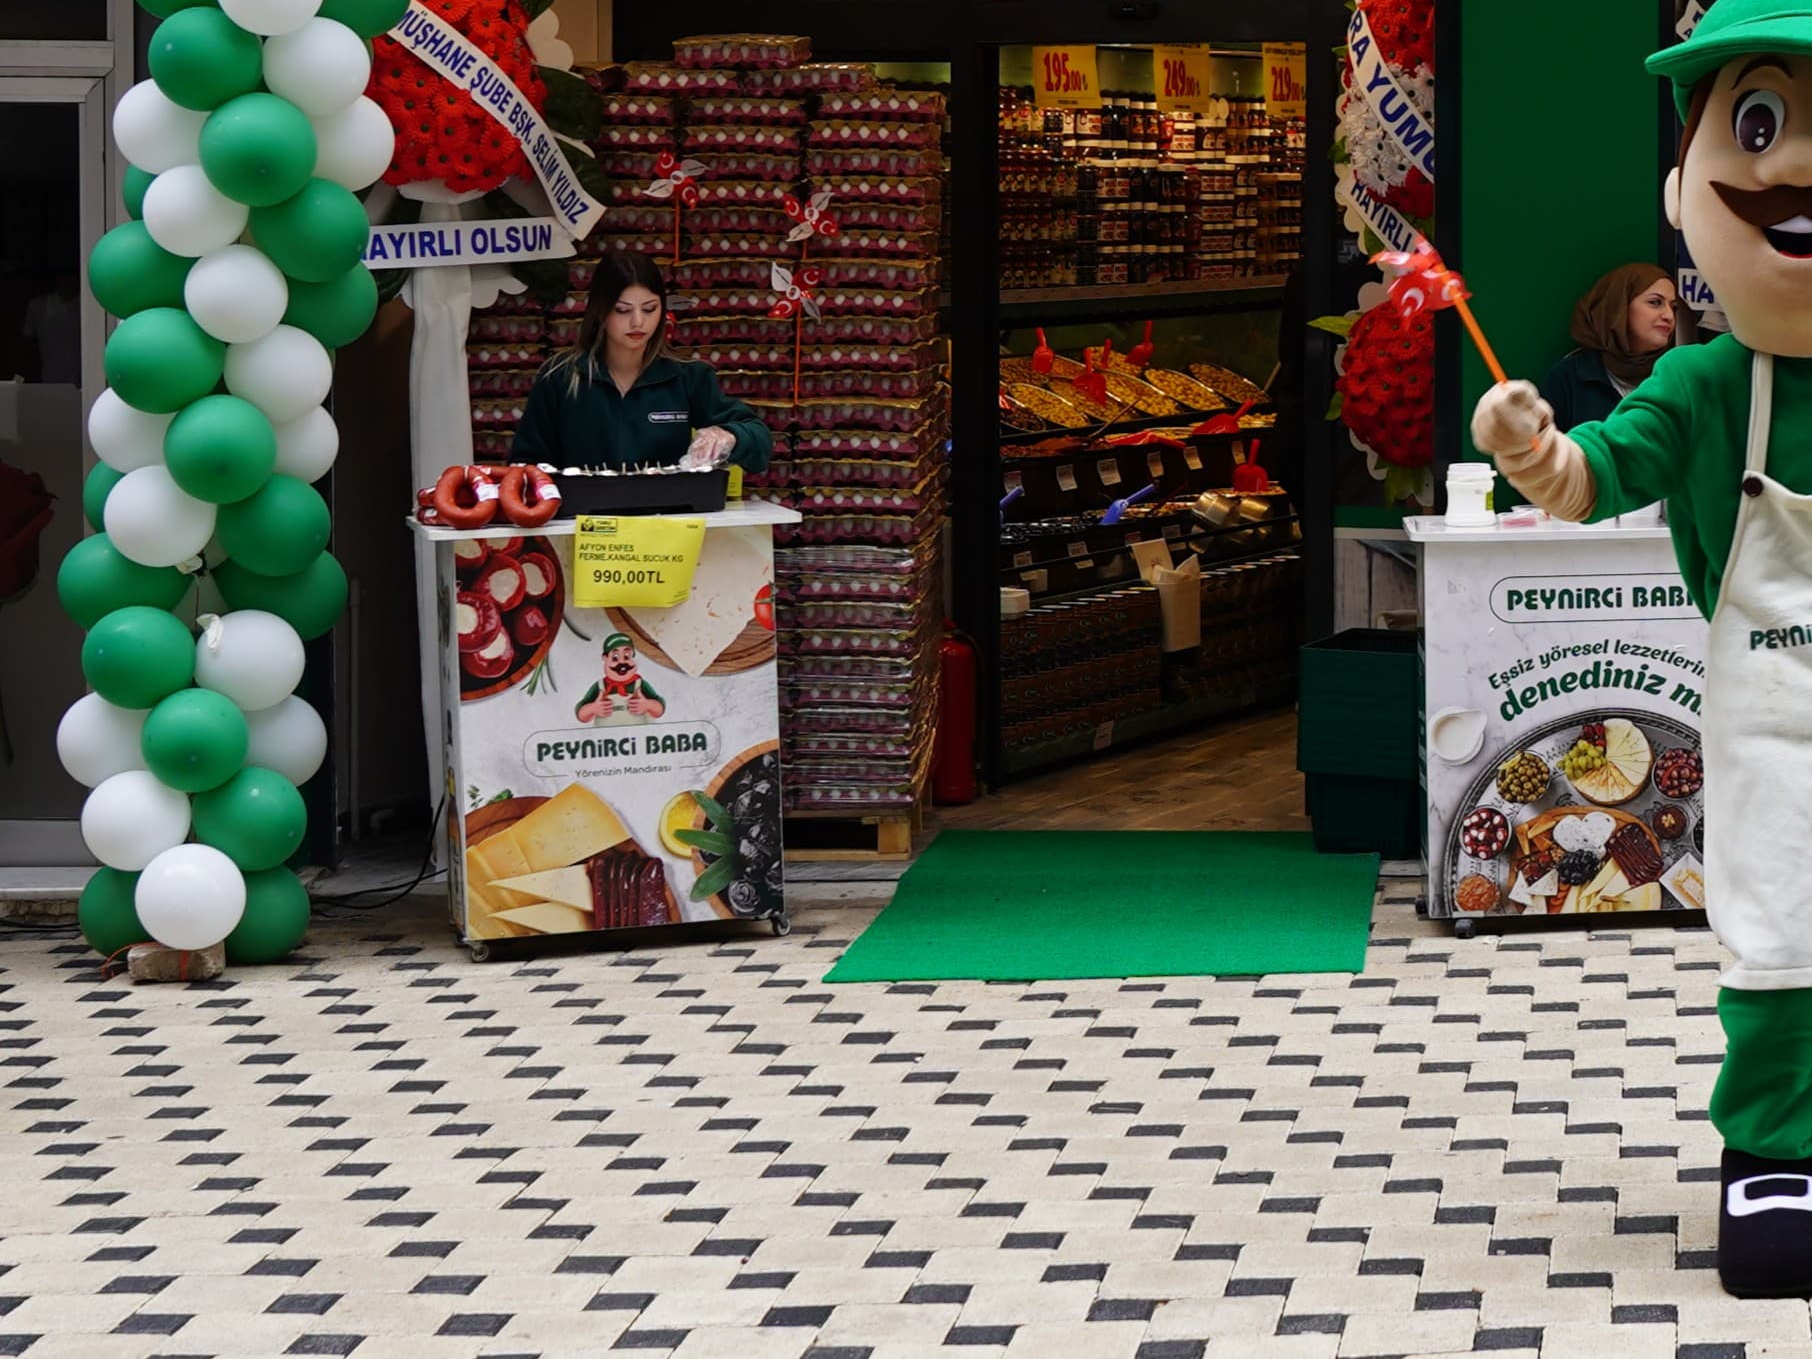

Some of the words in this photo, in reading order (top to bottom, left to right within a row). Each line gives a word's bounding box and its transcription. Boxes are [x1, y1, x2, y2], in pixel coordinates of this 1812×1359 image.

[468, 66, 514, 114] ŞUBE
[508, 99, 536, 145] BŞK.
[532, 132, 560, 181] SELİM
[551, 170, 590, 226] YILDIZ
[360, 227, 461, 261] AYIRLI
[470, 224, 553, 256] OLSUN
[593, 570, 665, 585] 990,00TL
[1488, 657, 1536, 690] Eşsiz
[1539, 639, 1609, 670] yöresel
[1614, 639, 1705, 679] lezzetleri
[1500, 660, 1668, 722] denediniz
[646, 732, 708, 755] BABA
[575, 767, 622, 779] Yörenizin
[624, 765, 672, 775] Mandırası
